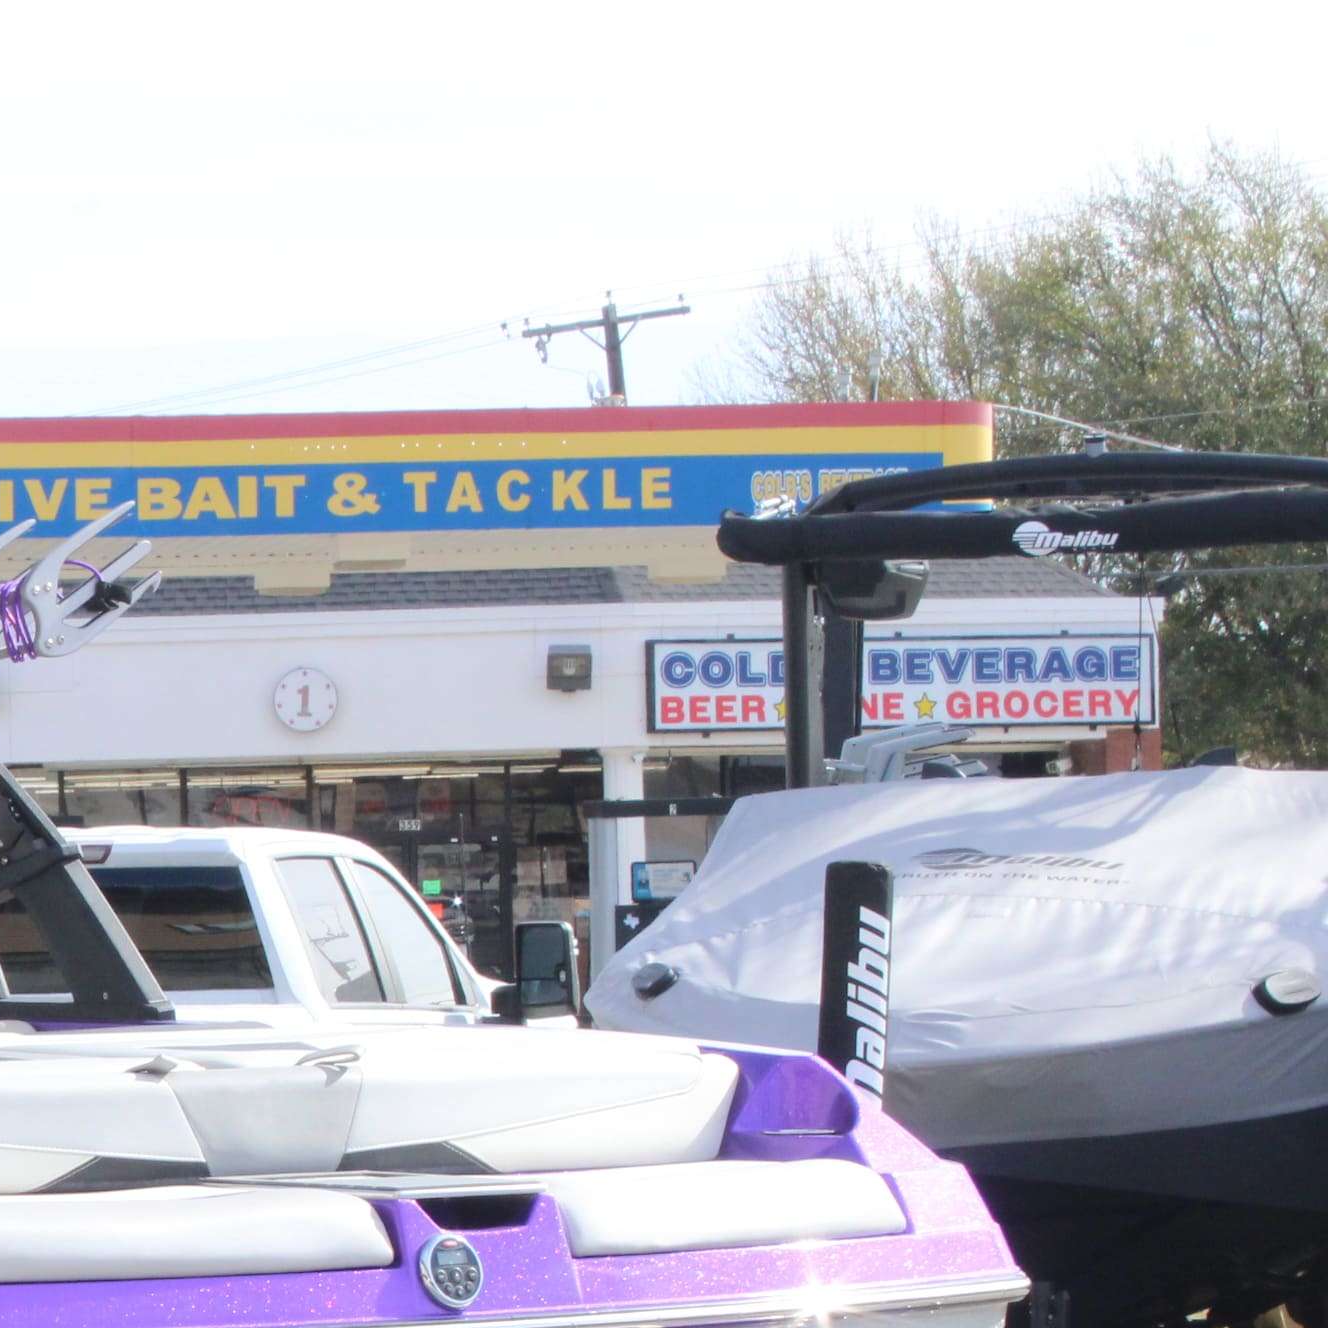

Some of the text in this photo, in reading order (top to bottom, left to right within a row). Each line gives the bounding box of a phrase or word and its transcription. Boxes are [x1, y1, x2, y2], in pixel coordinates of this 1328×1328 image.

[137, 474, 306, 521] BAIT
[327, 472, 381, 516] &
[402, 467, 673, 513] TACKLE
[868, 646, 1140, 684] BEVERAGE
[296, 684, 312, 717] 1
[660, 688, 1140, 724] BEER NE GROCERY
